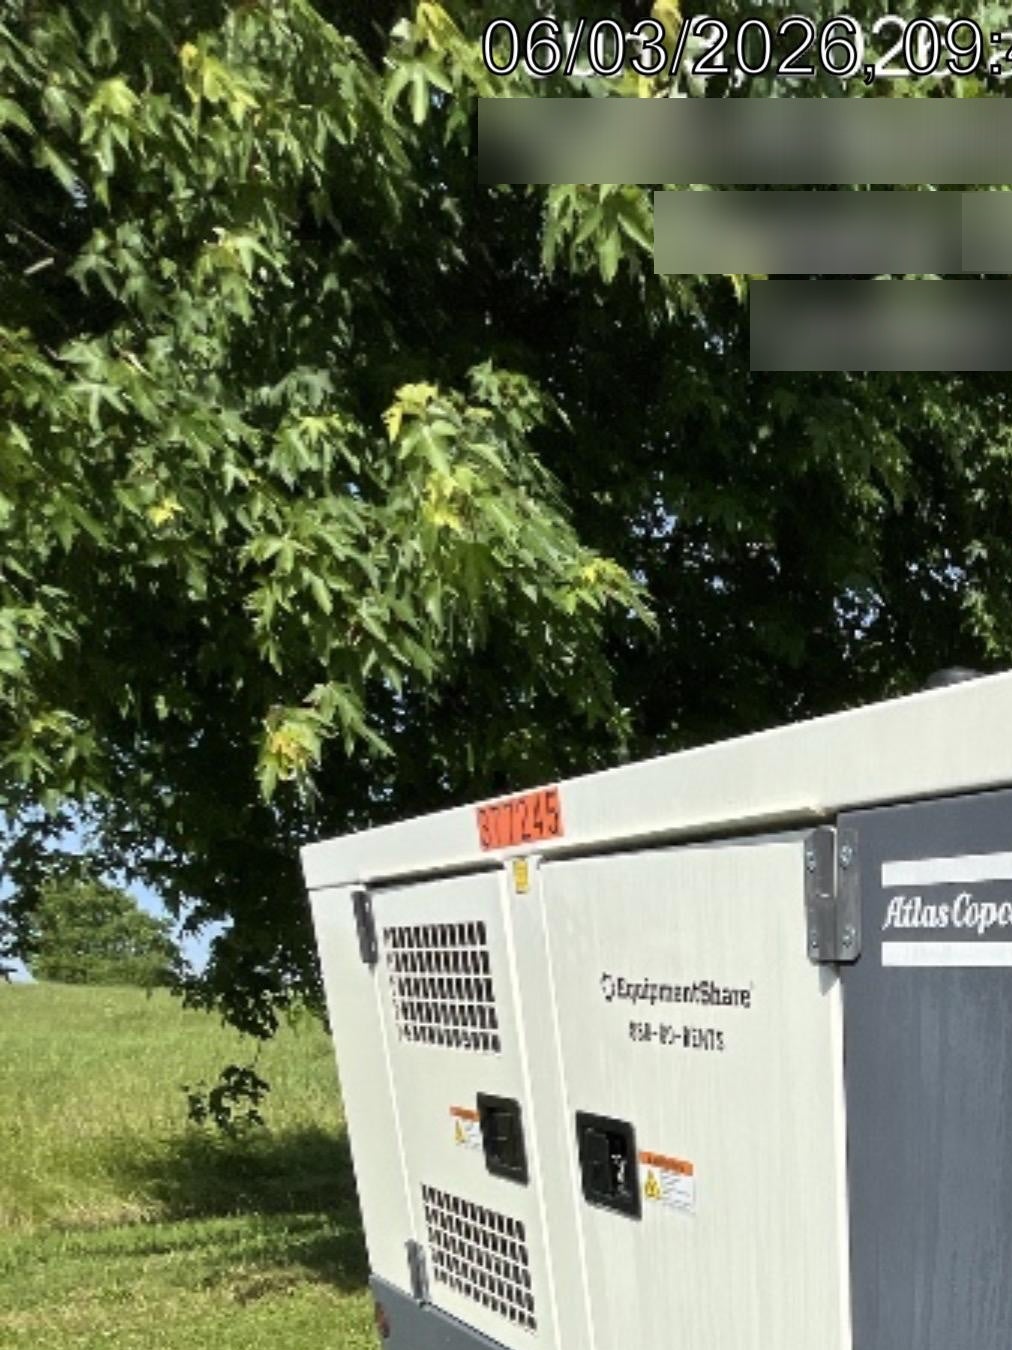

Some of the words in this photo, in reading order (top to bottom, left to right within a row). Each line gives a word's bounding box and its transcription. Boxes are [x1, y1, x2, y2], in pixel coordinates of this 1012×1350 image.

[479, 791, 560, 850] 377245
[881, 896, 949, 931] Atlas
[616, 977, 751, 1008] EquipmentShare
